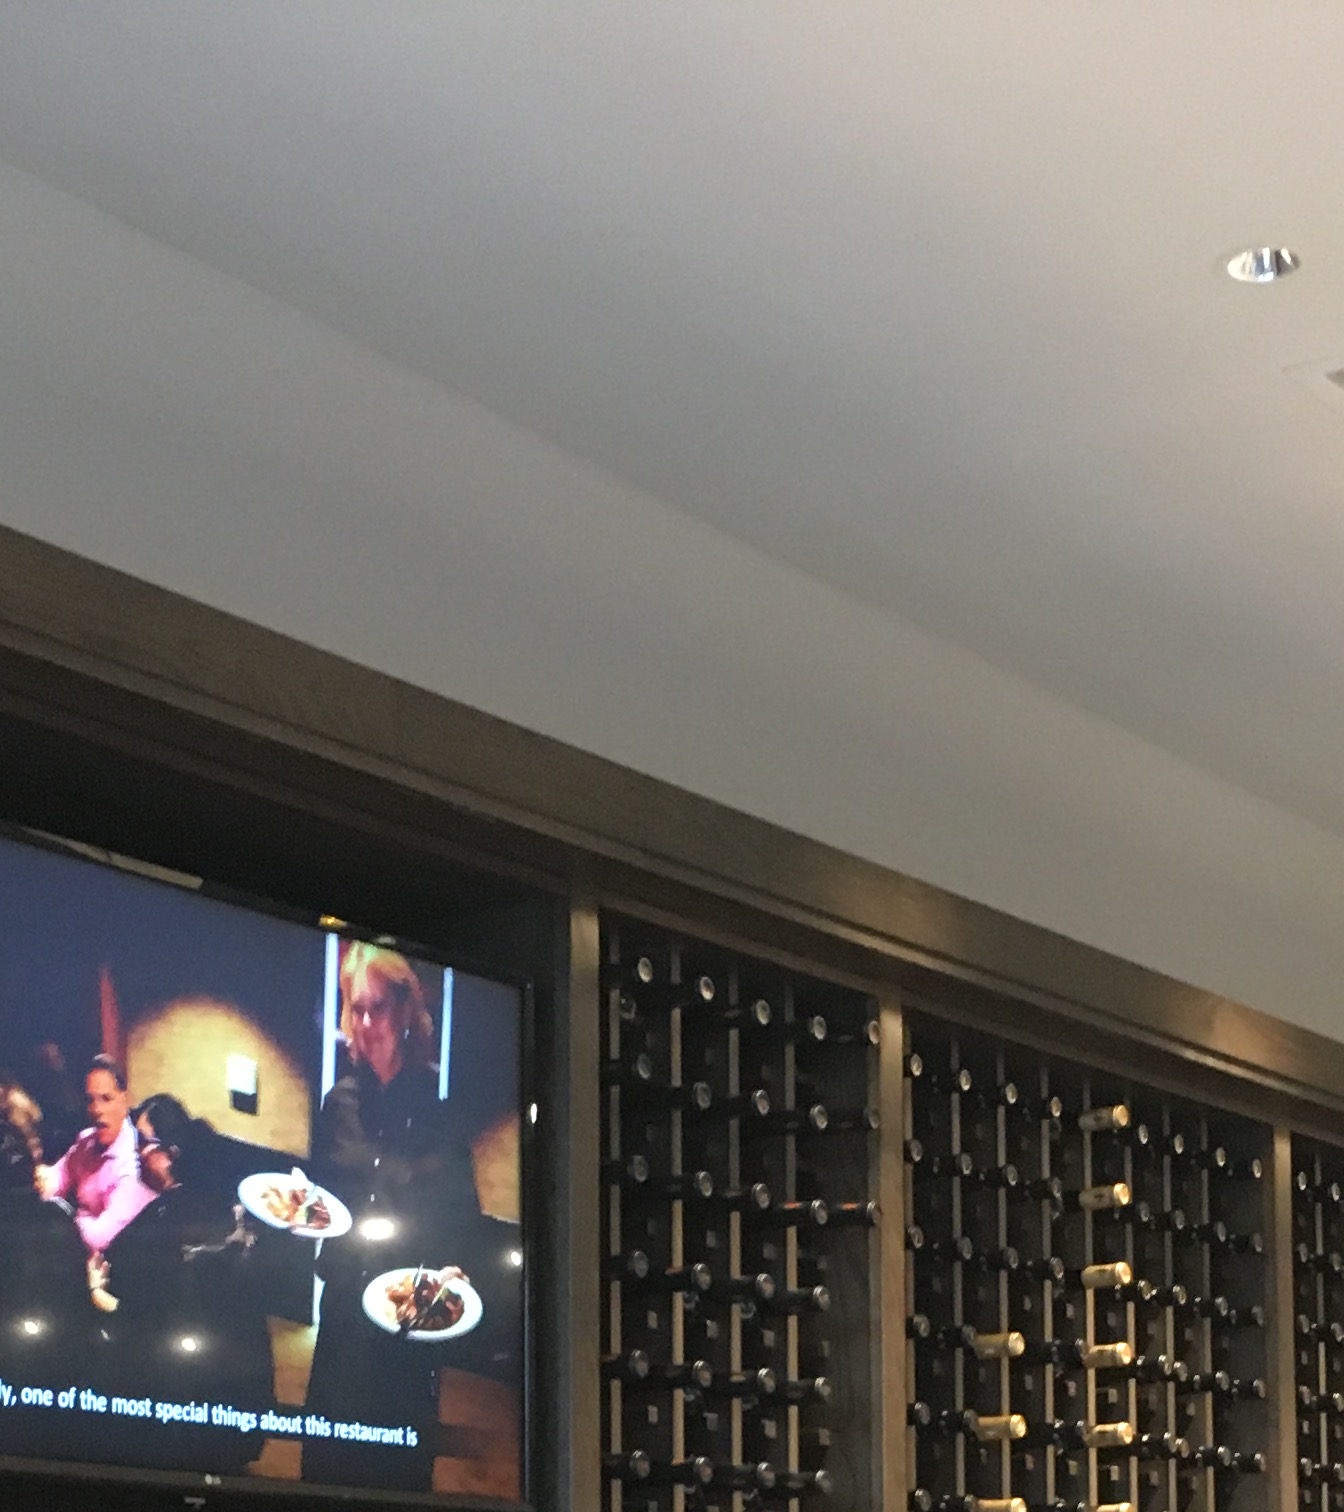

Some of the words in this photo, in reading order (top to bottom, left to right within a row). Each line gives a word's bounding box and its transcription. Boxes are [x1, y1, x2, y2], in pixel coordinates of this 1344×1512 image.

[21, 1387, 53, 1406] one
[58, 1387, 76, 1408] of
[80, 1389, 107, 1412] the
[112, 1397, 152, 1417] most
[155, 1401, 208, 1424] special
[212, 1404, 256, 1432] things
[260, 1410, 303, 1434] about
[305, 1415, 331, 1437] this
[334, 1422, 404, 1445] restaurant
[406, 1426, 418, 1447] is
